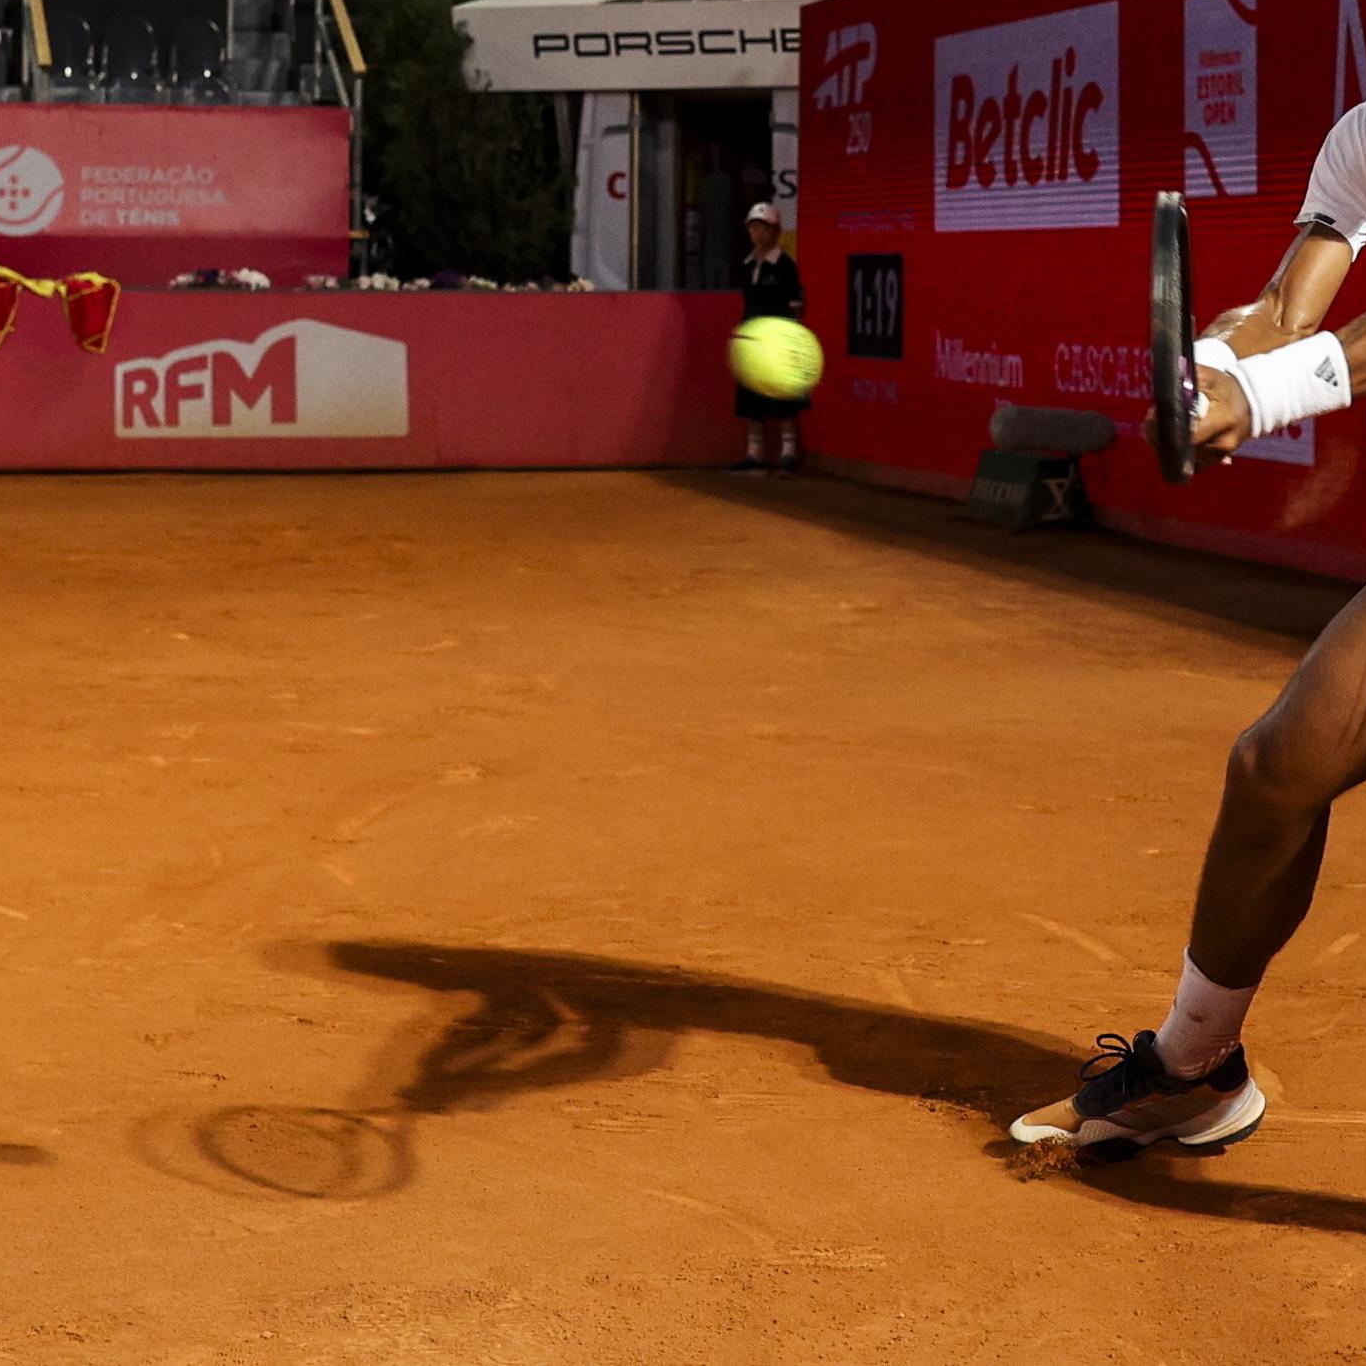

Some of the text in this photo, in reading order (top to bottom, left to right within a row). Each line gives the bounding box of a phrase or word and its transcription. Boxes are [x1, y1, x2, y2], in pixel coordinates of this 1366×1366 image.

[534, 27, 800, 59] PORSCHE
[945, 45, 1105, 190] Betclic
[854, 269, 899, 337] 1:19
[122, 333, 298, 429] RFM
